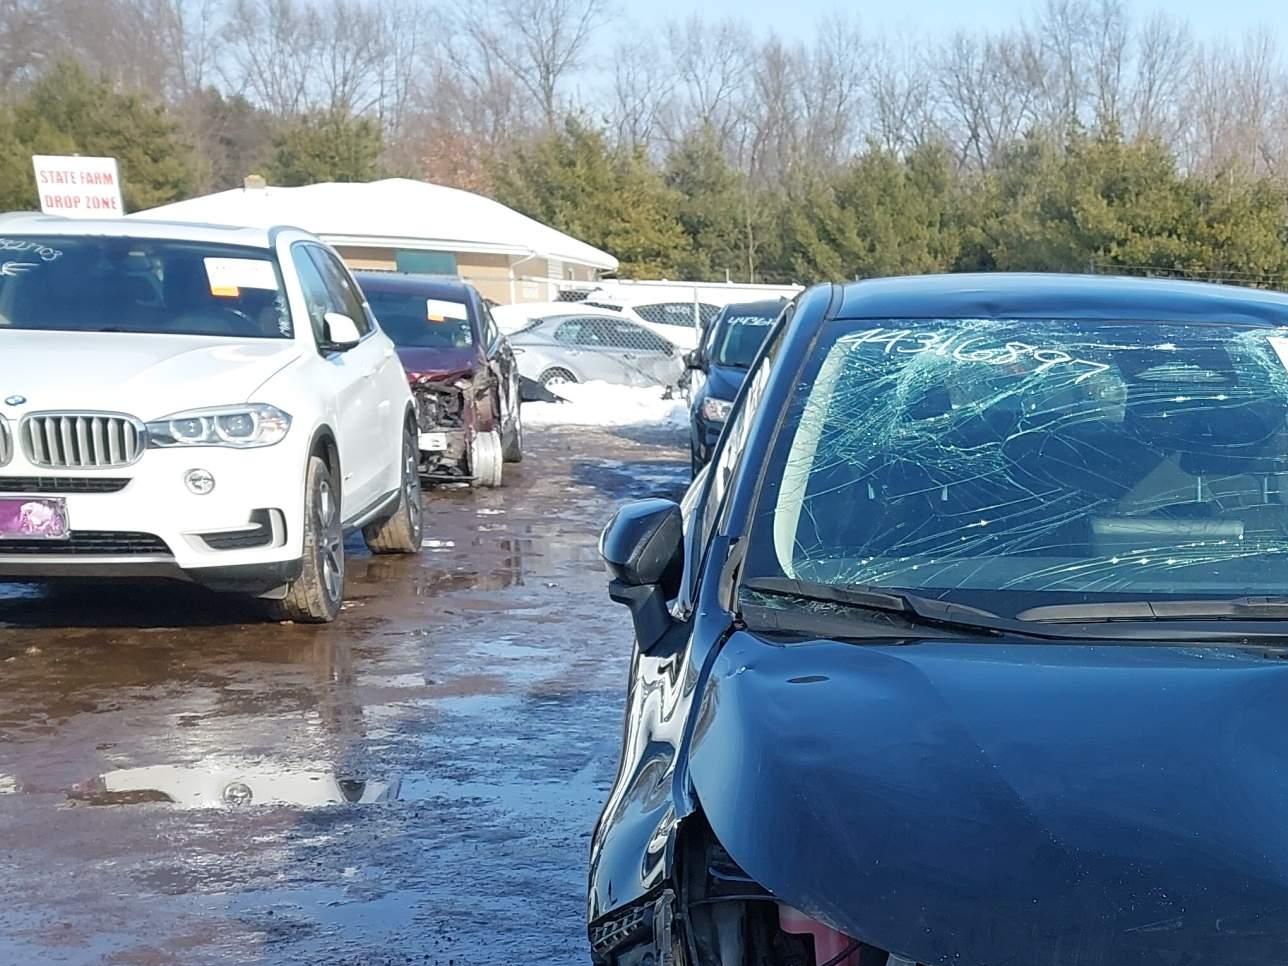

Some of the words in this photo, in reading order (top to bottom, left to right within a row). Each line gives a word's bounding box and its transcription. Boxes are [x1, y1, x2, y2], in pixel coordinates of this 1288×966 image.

[40, 170, 77, 184] STATE
[80, 171, 113, 185] FARM
[44, 195, 80, 209] DROP
[86, 196, 117, 210] ZONE
[836, 328, 1110, 384] 44316897
